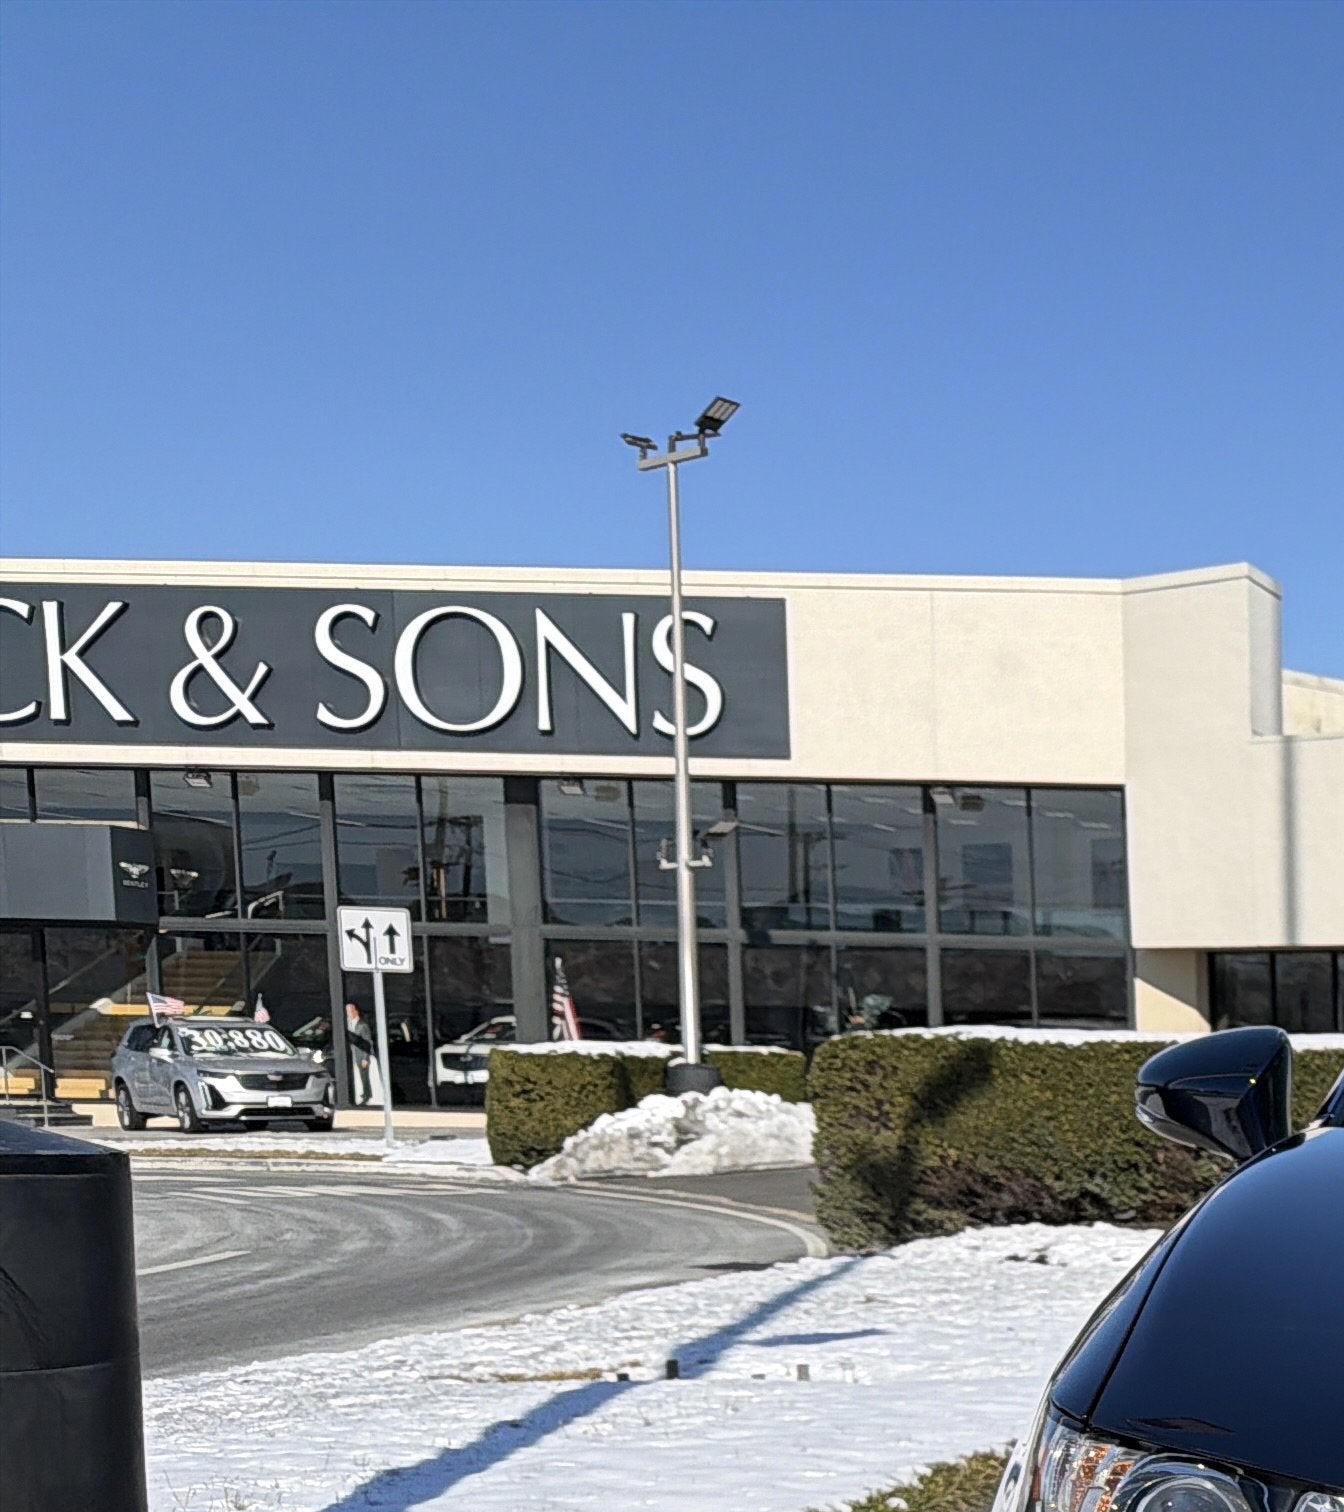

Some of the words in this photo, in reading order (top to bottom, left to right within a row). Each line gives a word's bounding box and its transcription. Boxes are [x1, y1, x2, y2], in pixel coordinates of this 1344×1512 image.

[170, 605, 271, 726] &
[314, 603, 723, 737] SONS
[379, 956, 405, 966] ONLY
